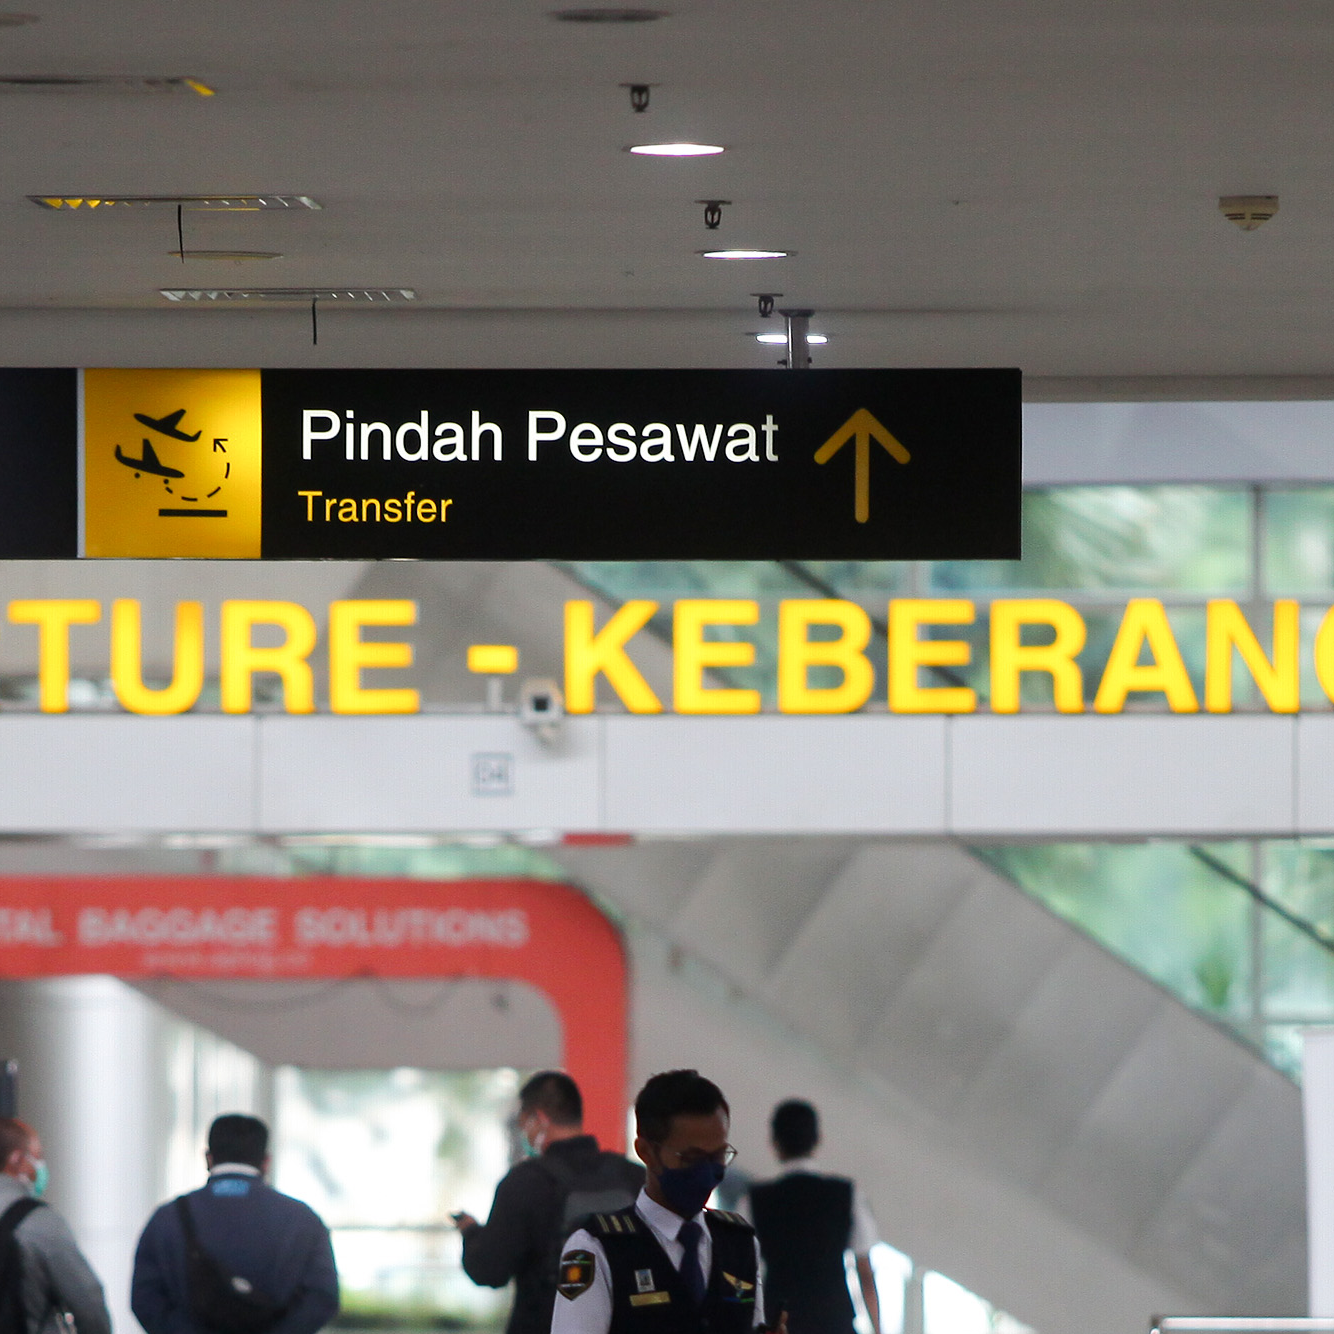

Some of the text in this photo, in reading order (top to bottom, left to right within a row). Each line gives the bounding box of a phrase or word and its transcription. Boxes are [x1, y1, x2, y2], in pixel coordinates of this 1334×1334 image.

[300, 409, 779, 462] Pindah Pesawat
[298, 490, 453, 522] Transfer
[468, 644, 519, 674] -
[78, 907, 277, 947] BAGGAGE
[295, 907, 529, 947] SOLUTIONS
